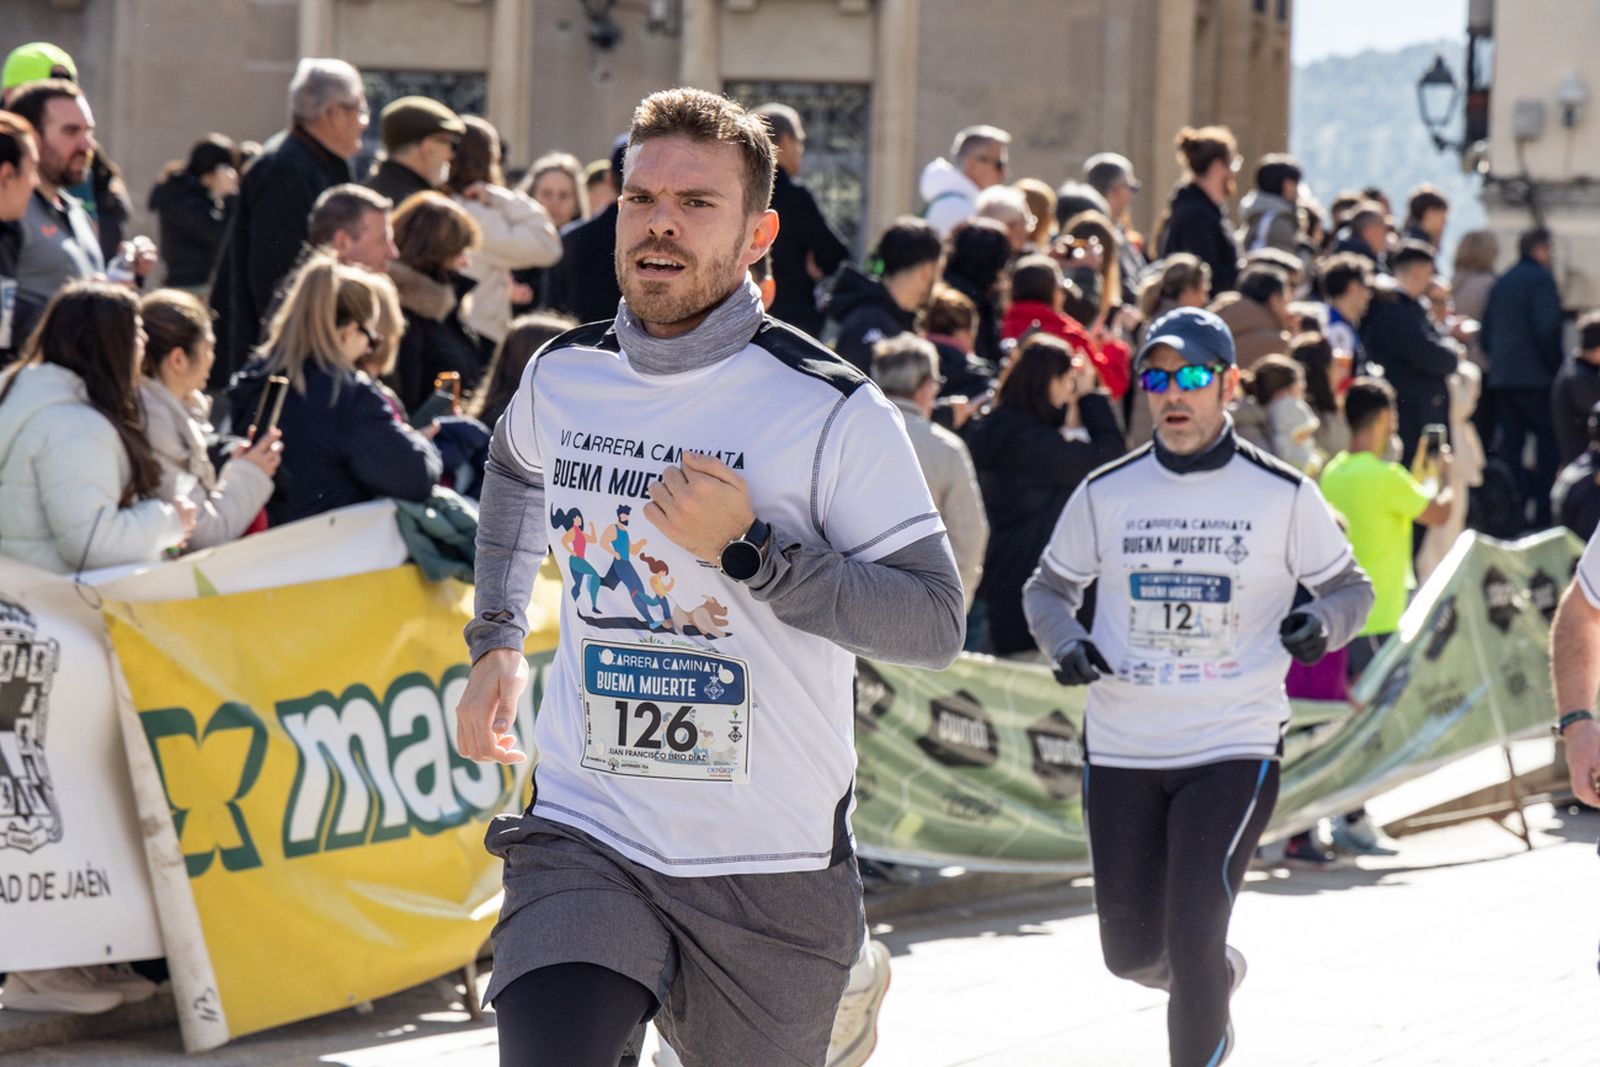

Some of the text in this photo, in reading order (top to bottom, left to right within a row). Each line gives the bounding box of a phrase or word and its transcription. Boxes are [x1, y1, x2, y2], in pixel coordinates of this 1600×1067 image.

[561, 429, 572, 447] VI
[573, 432, 645, 459] CARRERA
[552, 457, 602, 493] BUENA
[1137, 519, 1188, 531] CARRERA
[1191, 520, 1253, 532] CAMINATA
[1122, 536, 1224, 555] BUENA MUERTE
[1163, 604, 1193, 630] 12
[596, 670, 697, 697] BUENA MUERTE
[614, 701, 699, 753] 126
[624, 749, 667, 761] FRANCISCO
[28, 872, 56, 902] DE
